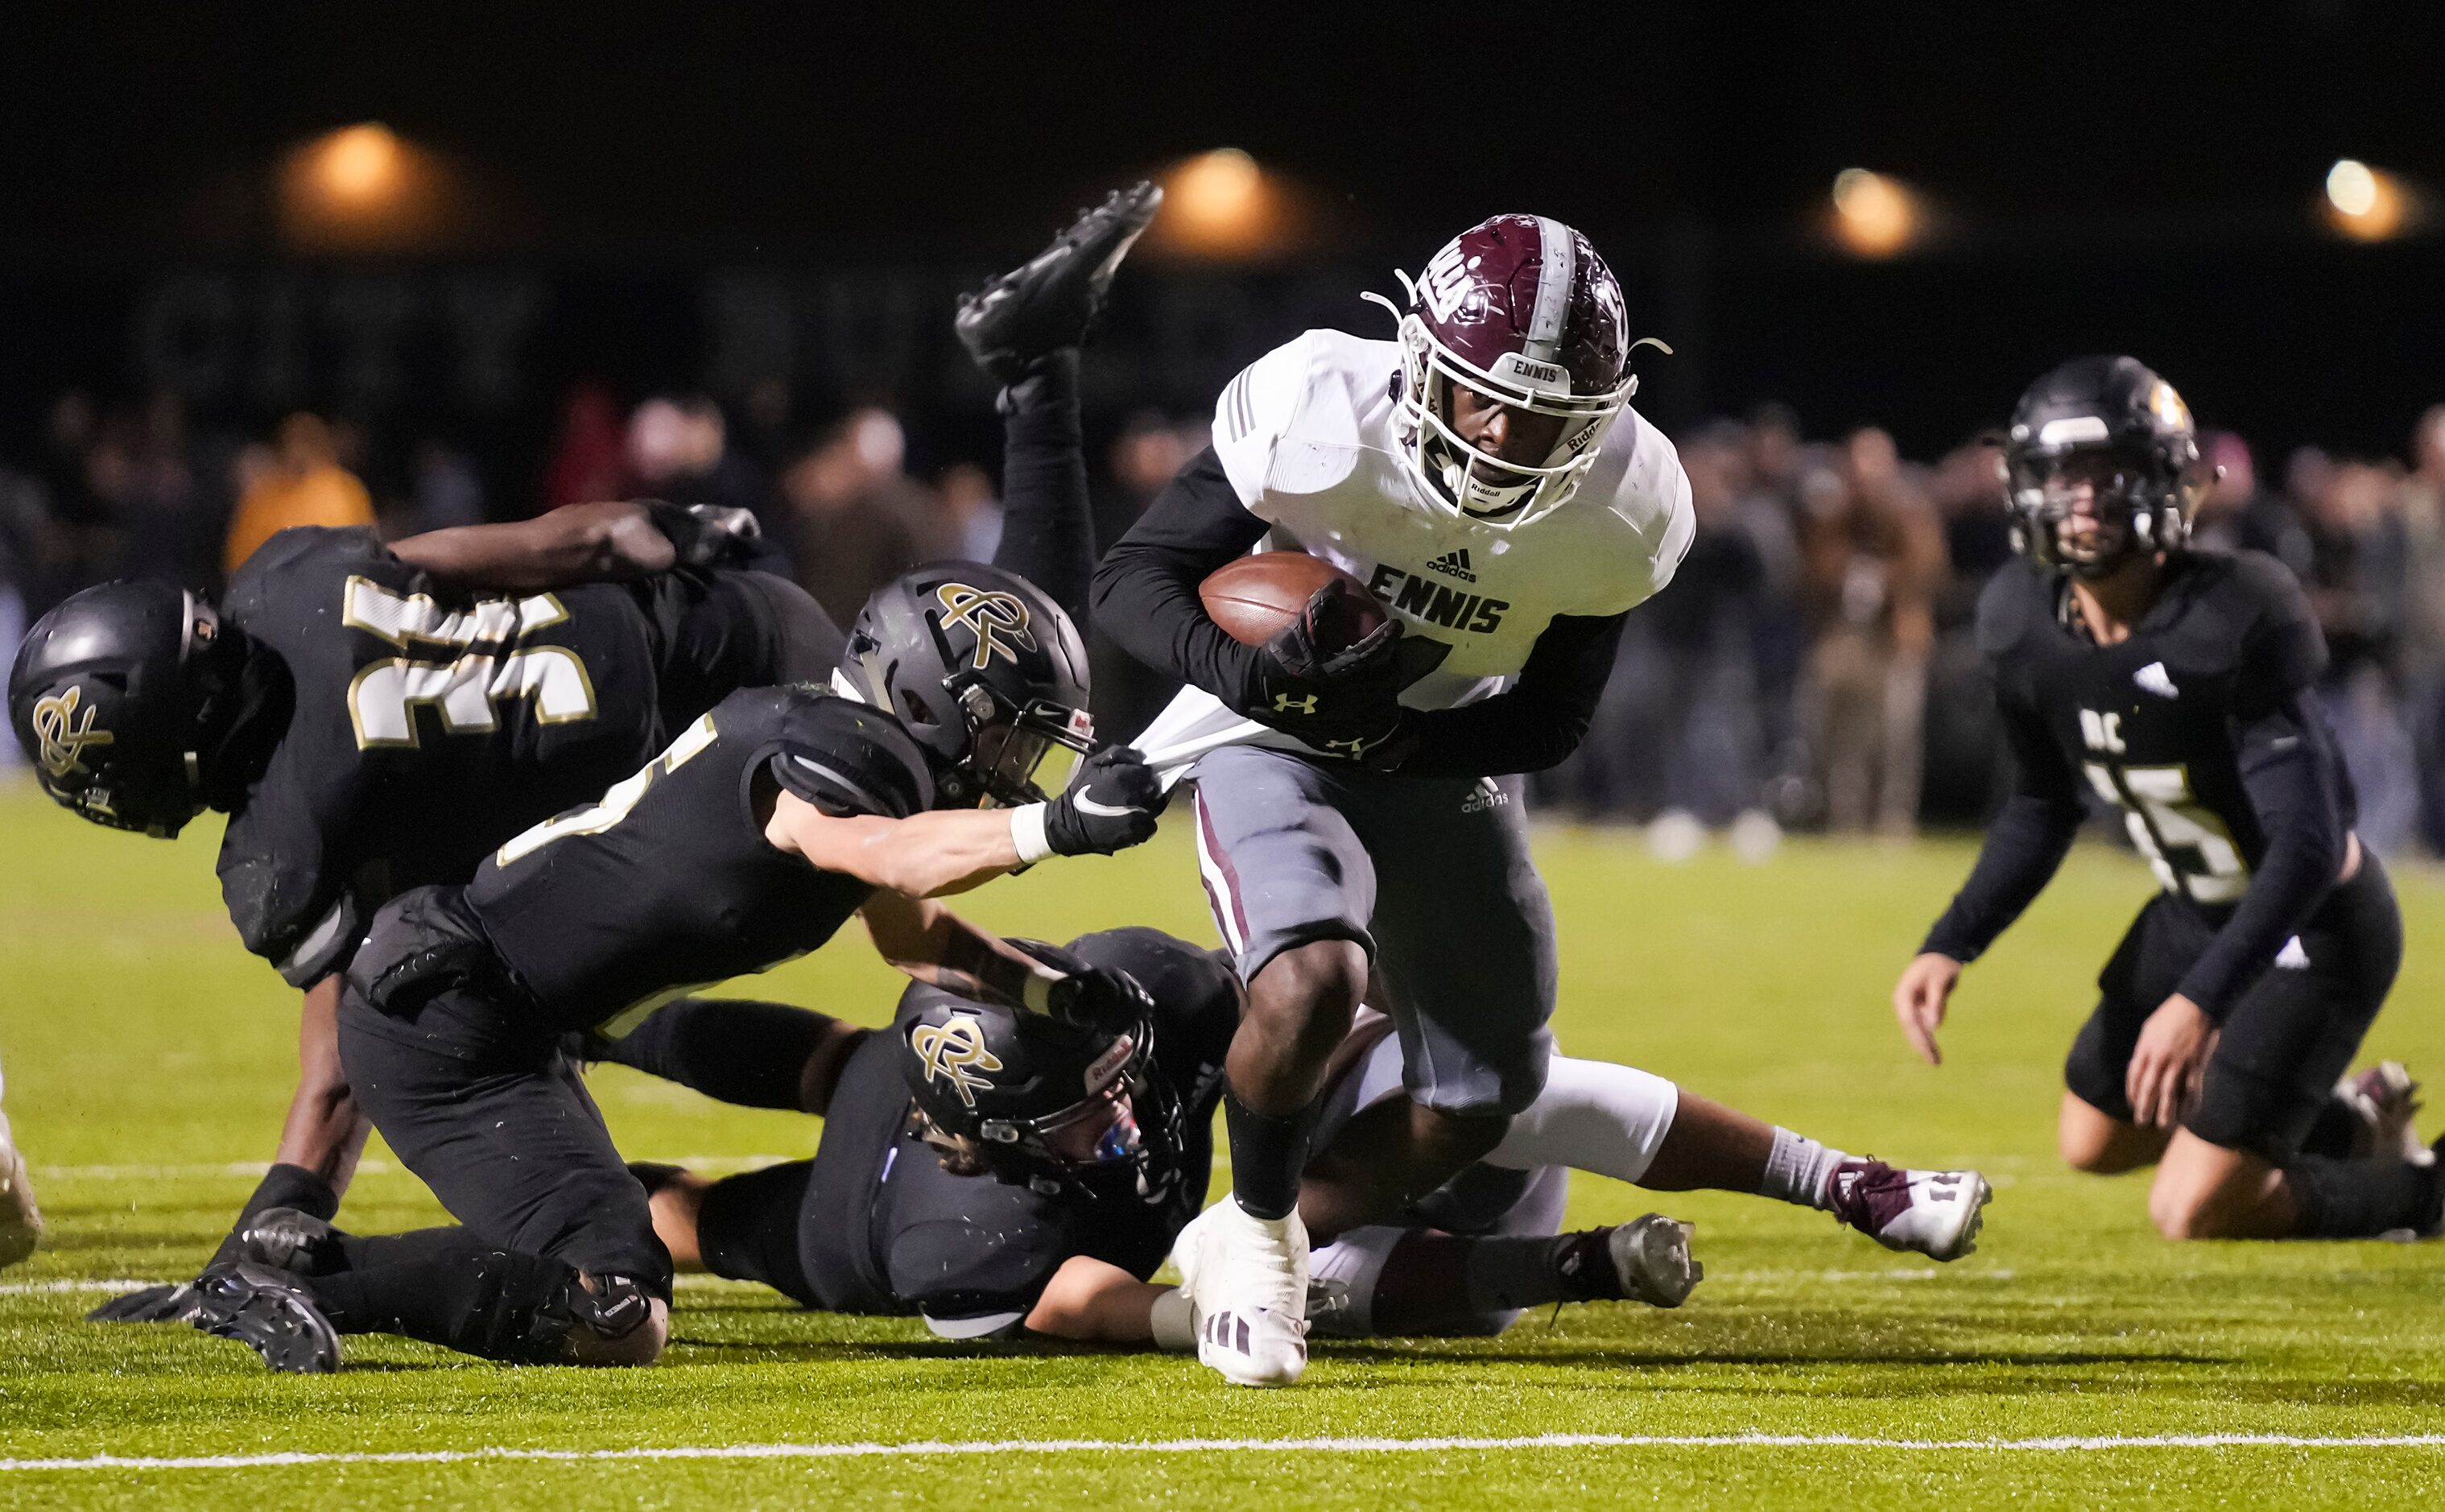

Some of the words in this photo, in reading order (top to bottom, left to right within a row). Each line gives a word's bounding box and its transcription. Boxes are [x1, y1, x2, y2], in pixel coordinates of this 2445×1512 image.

[1514, 360, 1557, 383] ENNIS
[1567, 423, 1600, 451] Ridd
[1471, 483, 1501, 498] Riddell
[1427, 560, 1476, 583] adidas
[1369, 564, 1510, 634] ENNIS
[1461, 792, 1509, 813] adidas
[2083, 760, 2252, 903] 15
